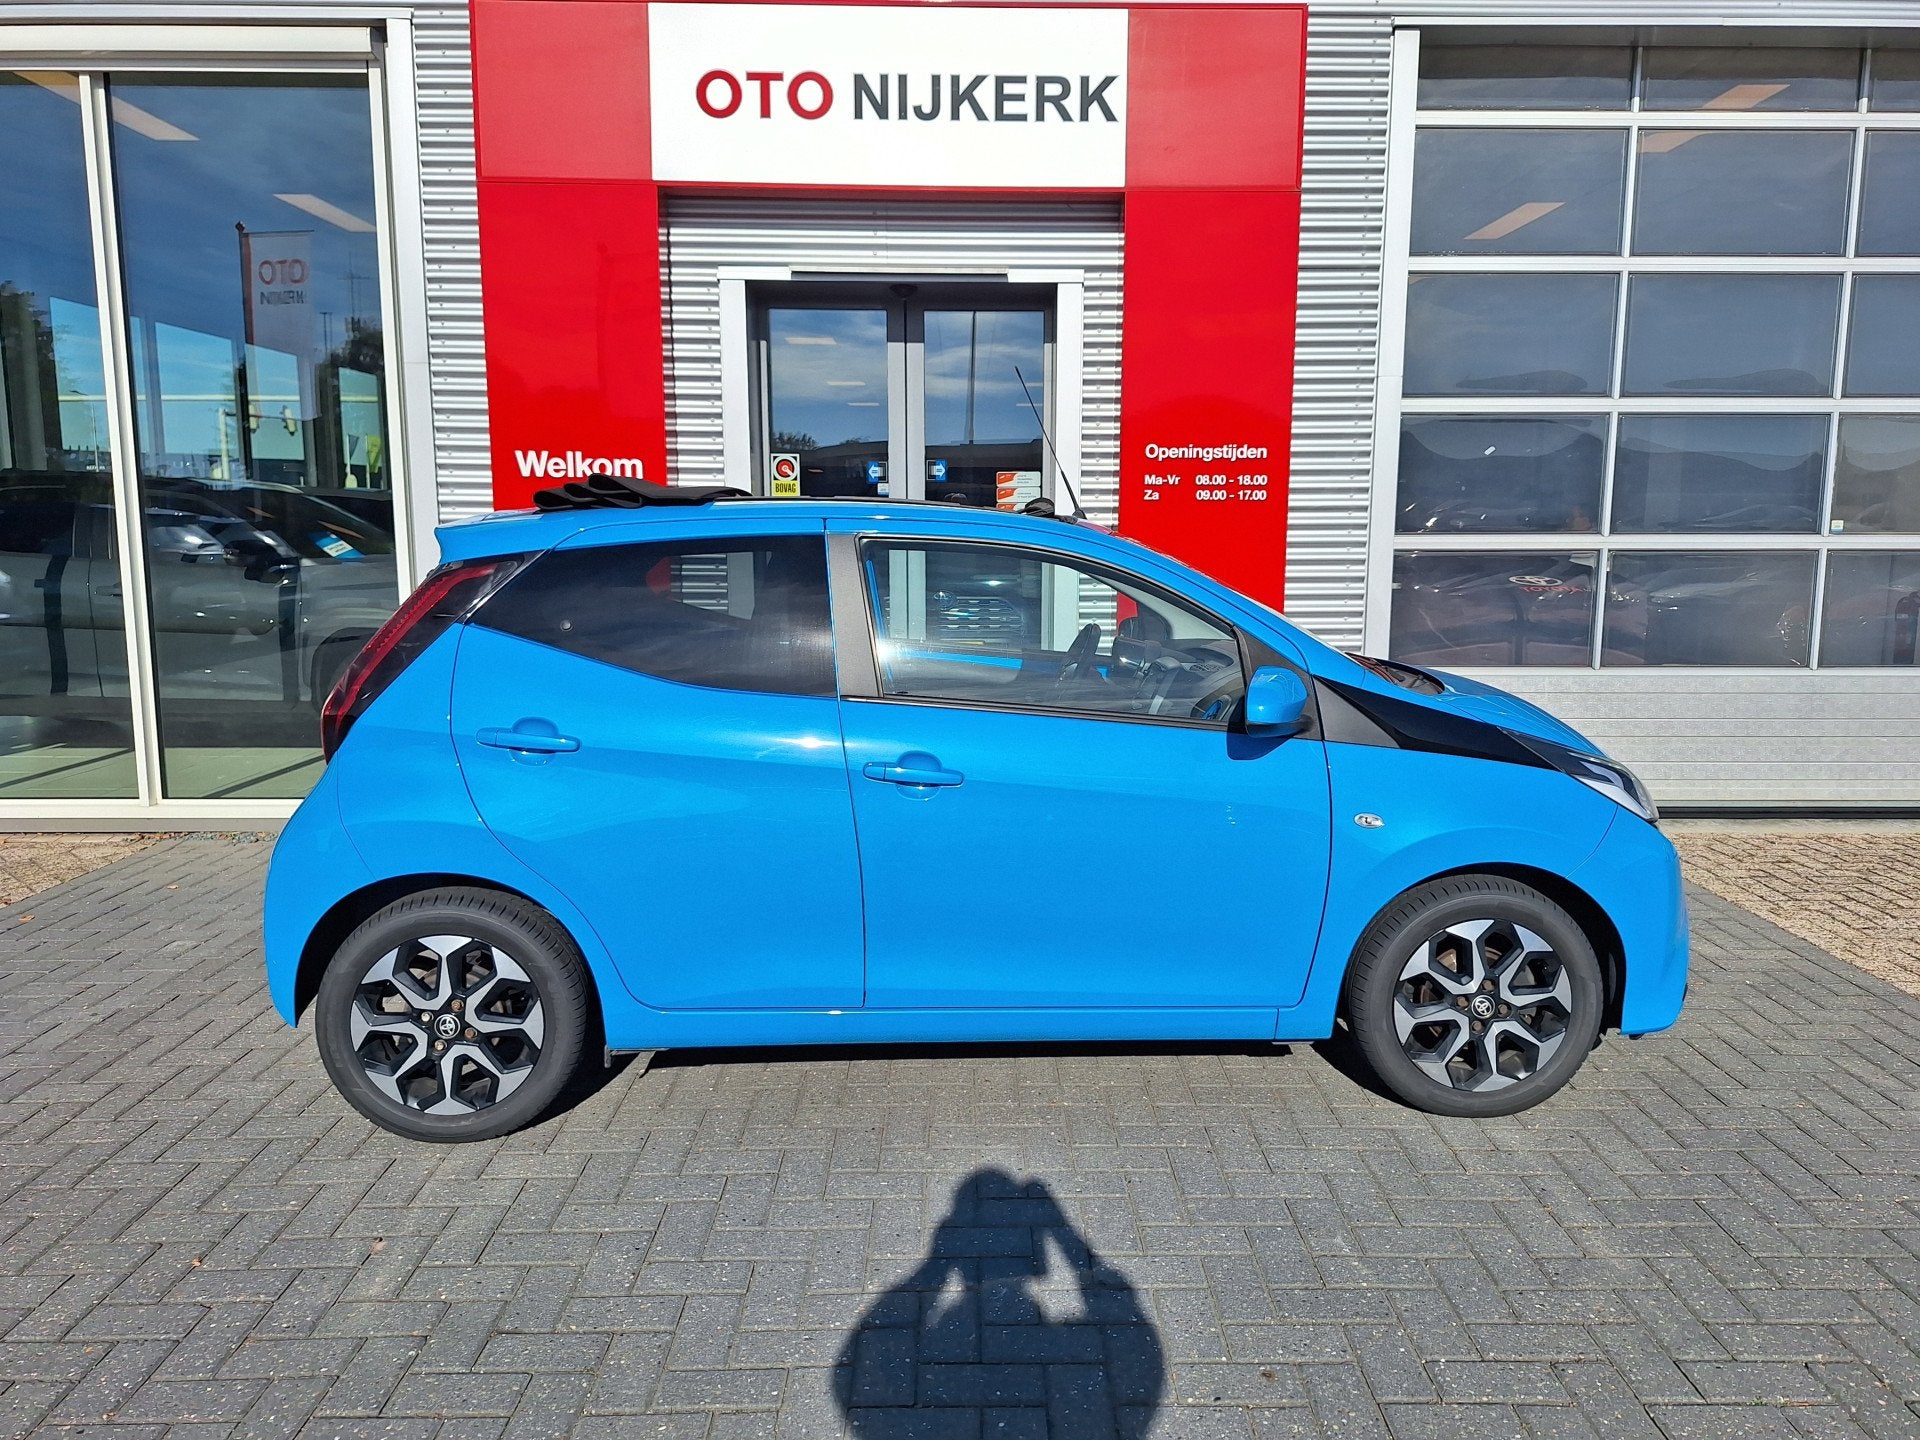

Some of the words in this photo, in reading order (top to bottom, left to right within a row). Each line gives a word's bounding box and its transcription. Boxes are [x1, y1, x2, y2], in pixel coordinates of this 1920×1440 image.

[696, 68, 834, 120] OTO
[853, 73, 1119, 122] NIJKERK
[259, 259, 309, 285] OTO
[1145, 443, 1268, 461] Openingstijden
[514, 449, 644, 479] Welkom
[775, 482, 797, 494] BOVAG
[1144, 474, 1181, 485] Ma-Vr
[1195, 474, 1227, 486] 08.00
[1237, 474, 1268, 486] 18.00
[1143, 489, 1160, 500] Za
[1196, 489, 1227, 501] 09.00
[1237, 489, 1267, 501] 17.00
